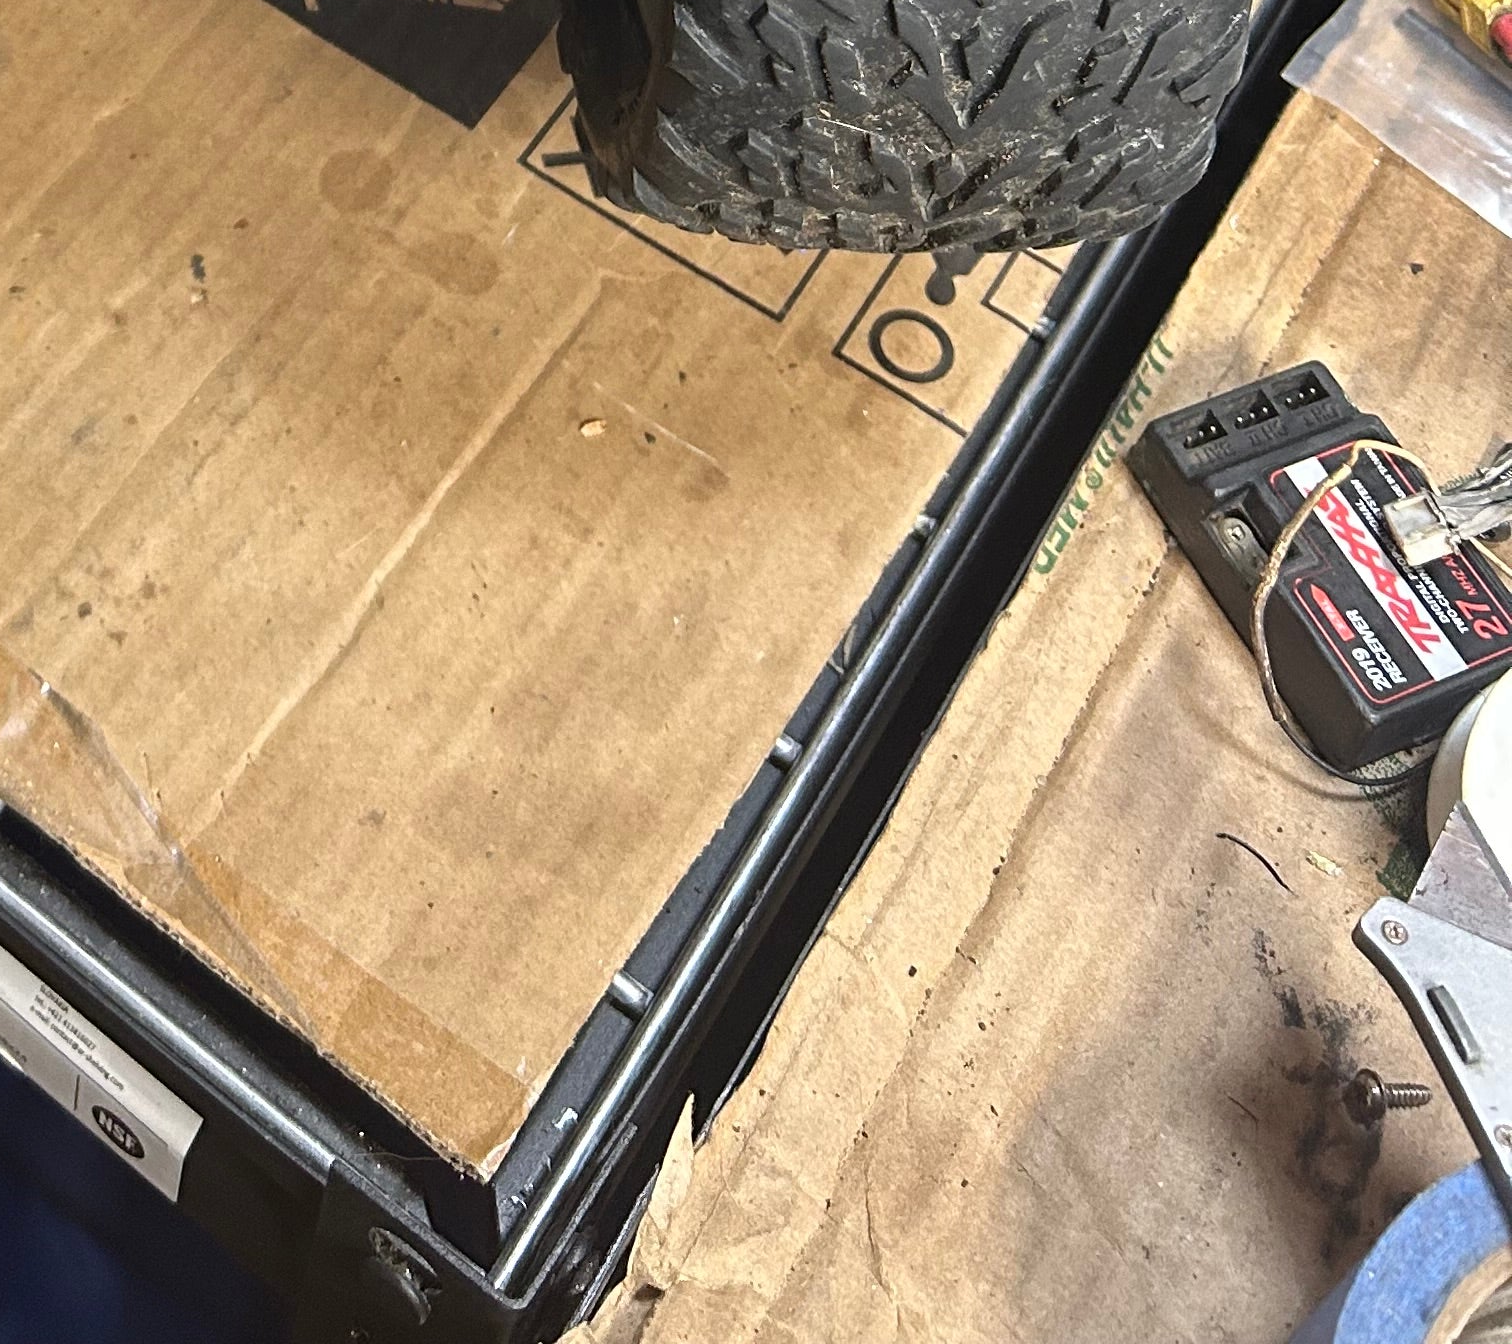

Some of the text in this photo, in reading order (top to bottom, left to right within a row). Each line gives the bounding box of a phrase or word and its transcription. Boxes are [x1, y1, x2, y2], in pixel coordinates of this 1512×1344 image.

[1388, 482, 1407, 501] ADE
[1412, 581, 1452, 624] DIGITAL
[1453, 596, 1508, 642] 27
[1344, 607, 1409, 685] RECEIVER
[1349, 644, 1394, 692] 2019
[96, 1107, 139, 1155] NSF
